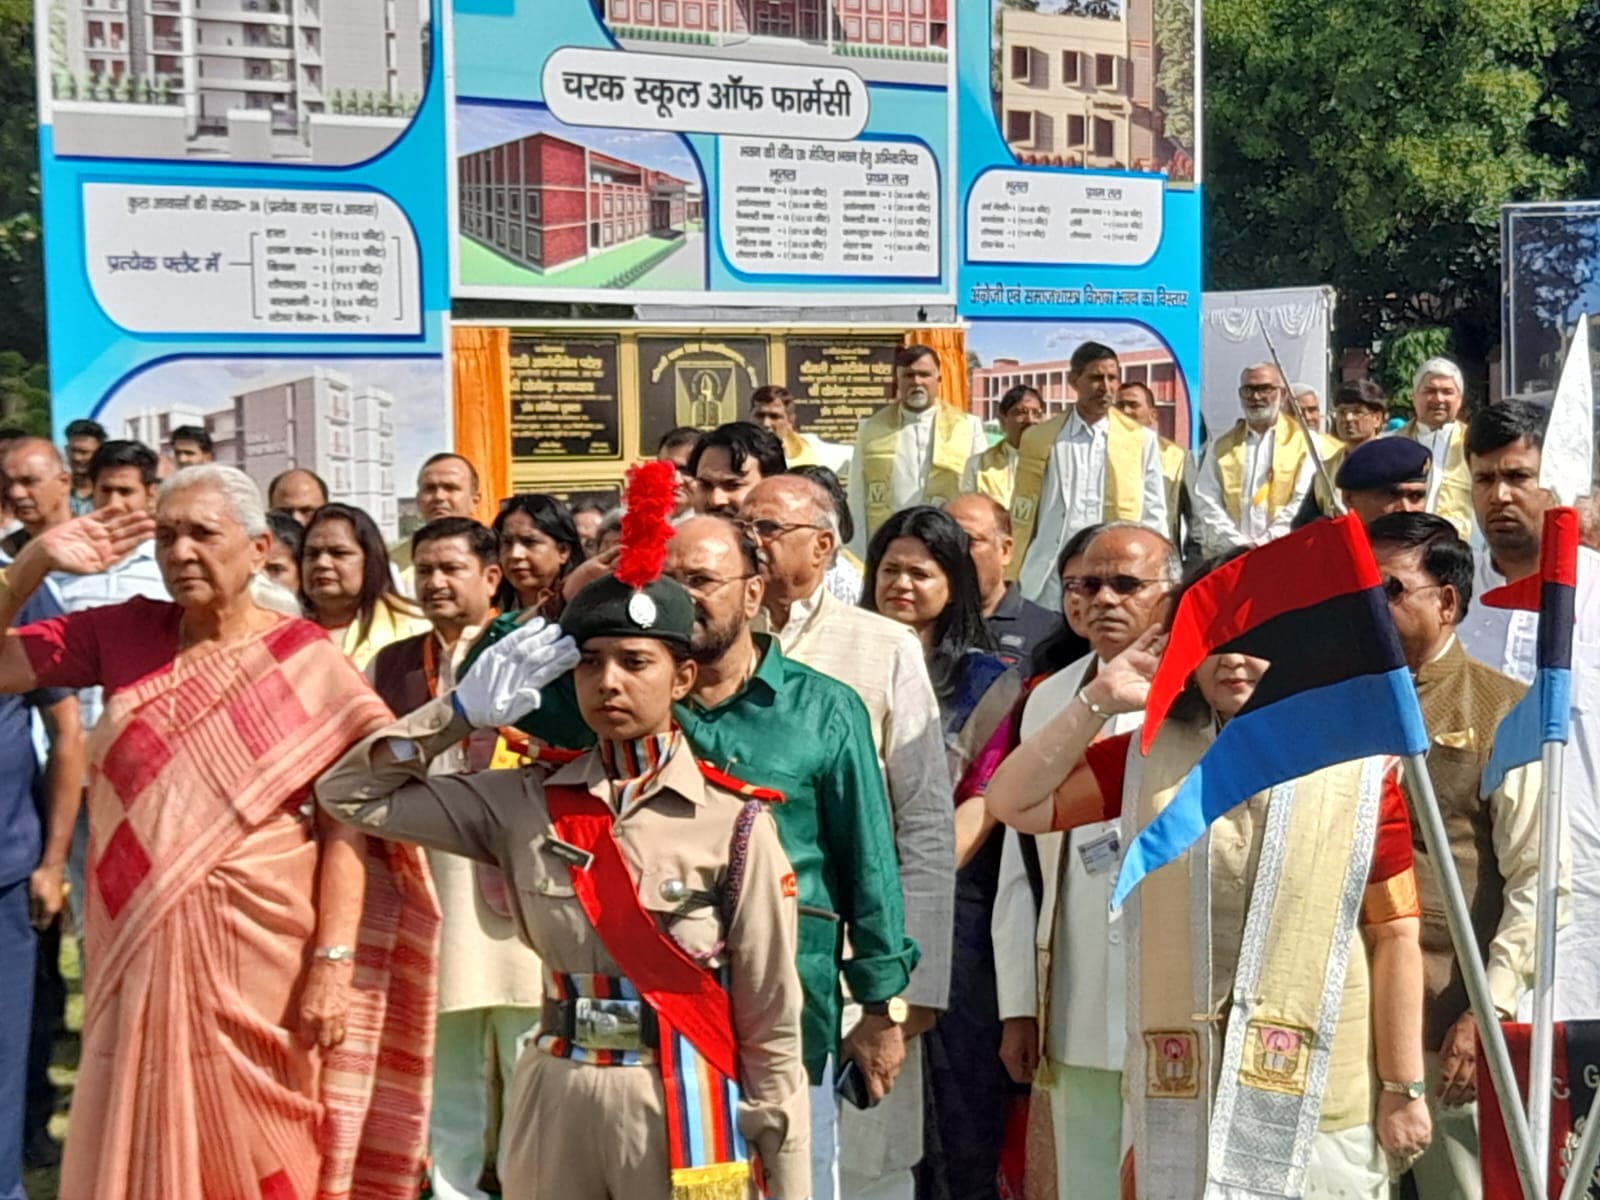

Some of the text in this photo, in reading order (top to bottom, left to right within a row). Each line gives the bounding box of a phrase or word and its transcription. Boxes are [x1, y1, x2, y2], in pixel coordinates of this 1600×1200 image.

[562, 72, 852, 118] चरक स्कूल ऑफ फार्मेसी
[769, 168, 797, 185] भूतल
[106, 250, 222, 274] प्रत्येक फ्लैट में
[969, 281, 1004, 307] अंग्रेजी
[1006, 281, 1022, 306] एवं
[1140, 291, 1155, 307] का
